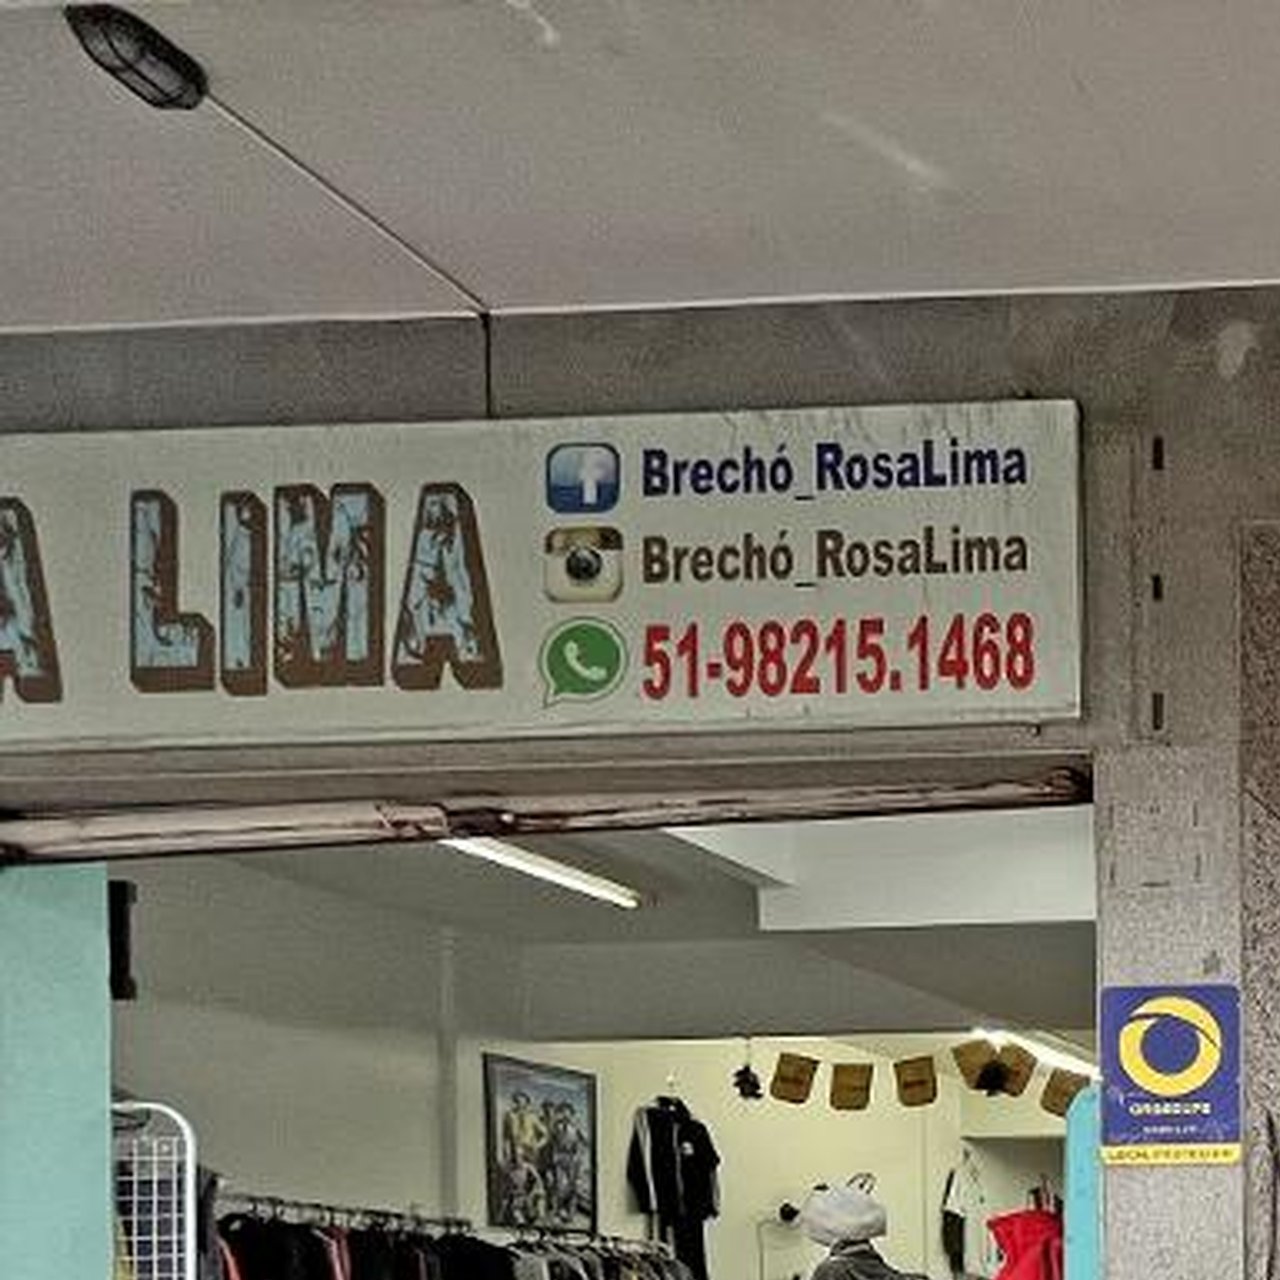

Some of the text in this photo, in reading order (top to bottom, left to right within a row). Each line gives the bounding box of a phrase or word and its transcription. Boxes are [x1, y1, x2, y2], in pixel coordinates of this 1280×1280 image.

[641, 441, 1029, 499] Brechó_RosaLima
[130, 482, 503, 697] LIMA
[641, 528, 1030, 588] Brechó_RosaLima
[641, 612, 1035, 701] 51-98215.1468
